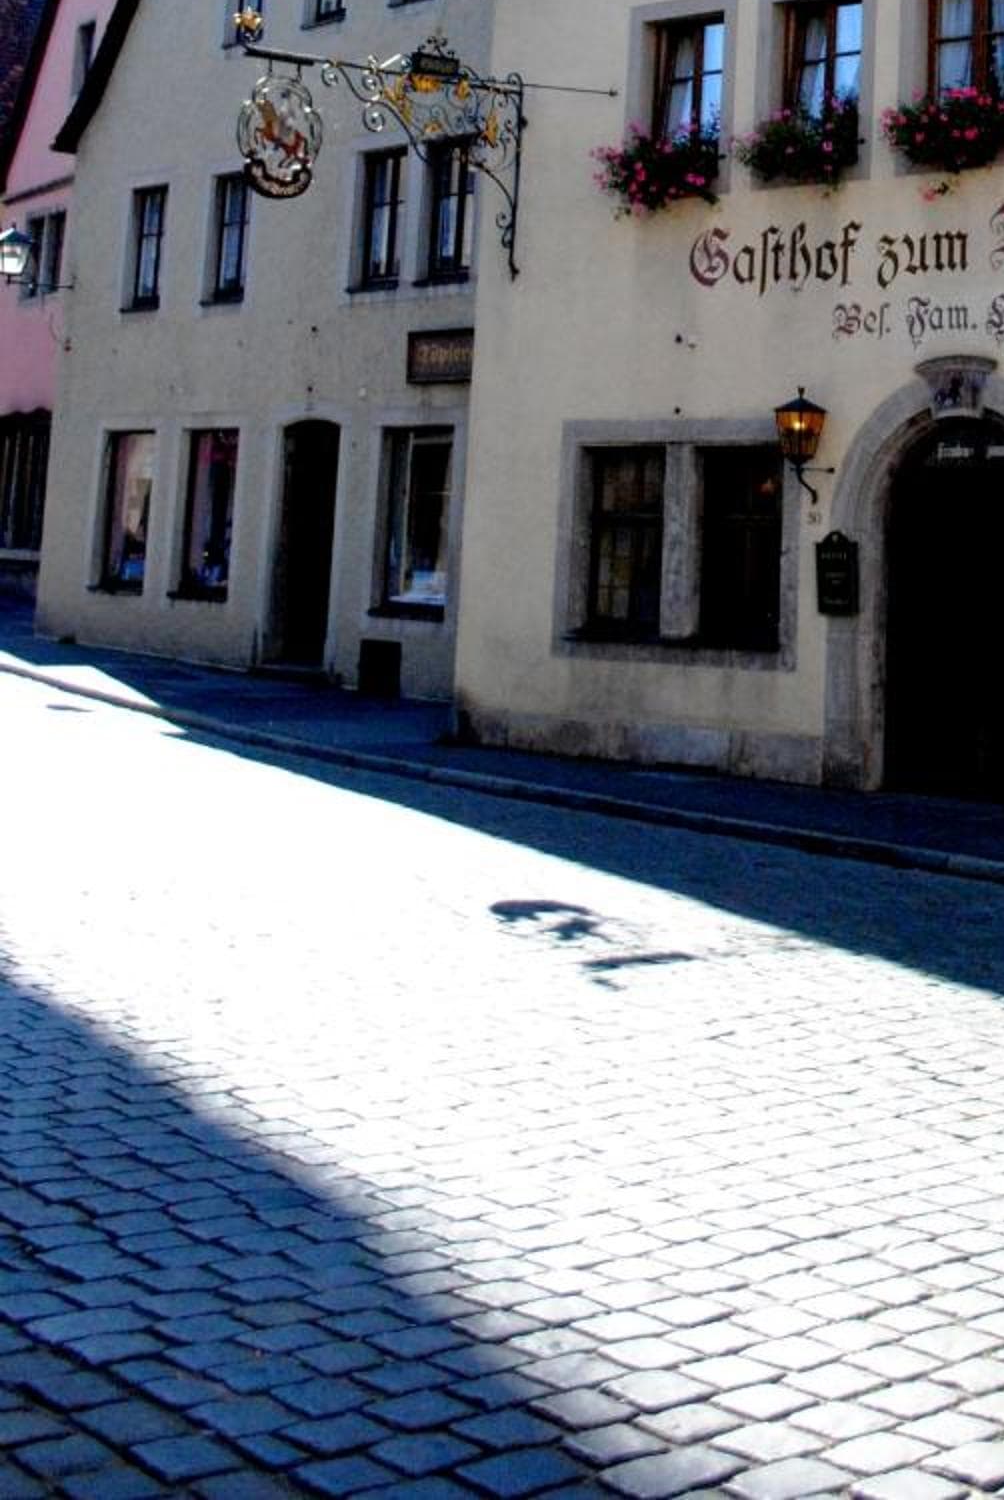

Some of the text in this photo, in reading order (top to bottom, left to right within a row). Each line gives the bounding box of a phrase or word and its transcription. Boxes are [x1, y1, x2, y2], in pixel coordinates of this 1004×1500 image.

[689, 221, 866, 295] Gasthof
[876, 230, 970, 289] zum
[906, 293, 977, 350] Fam.
